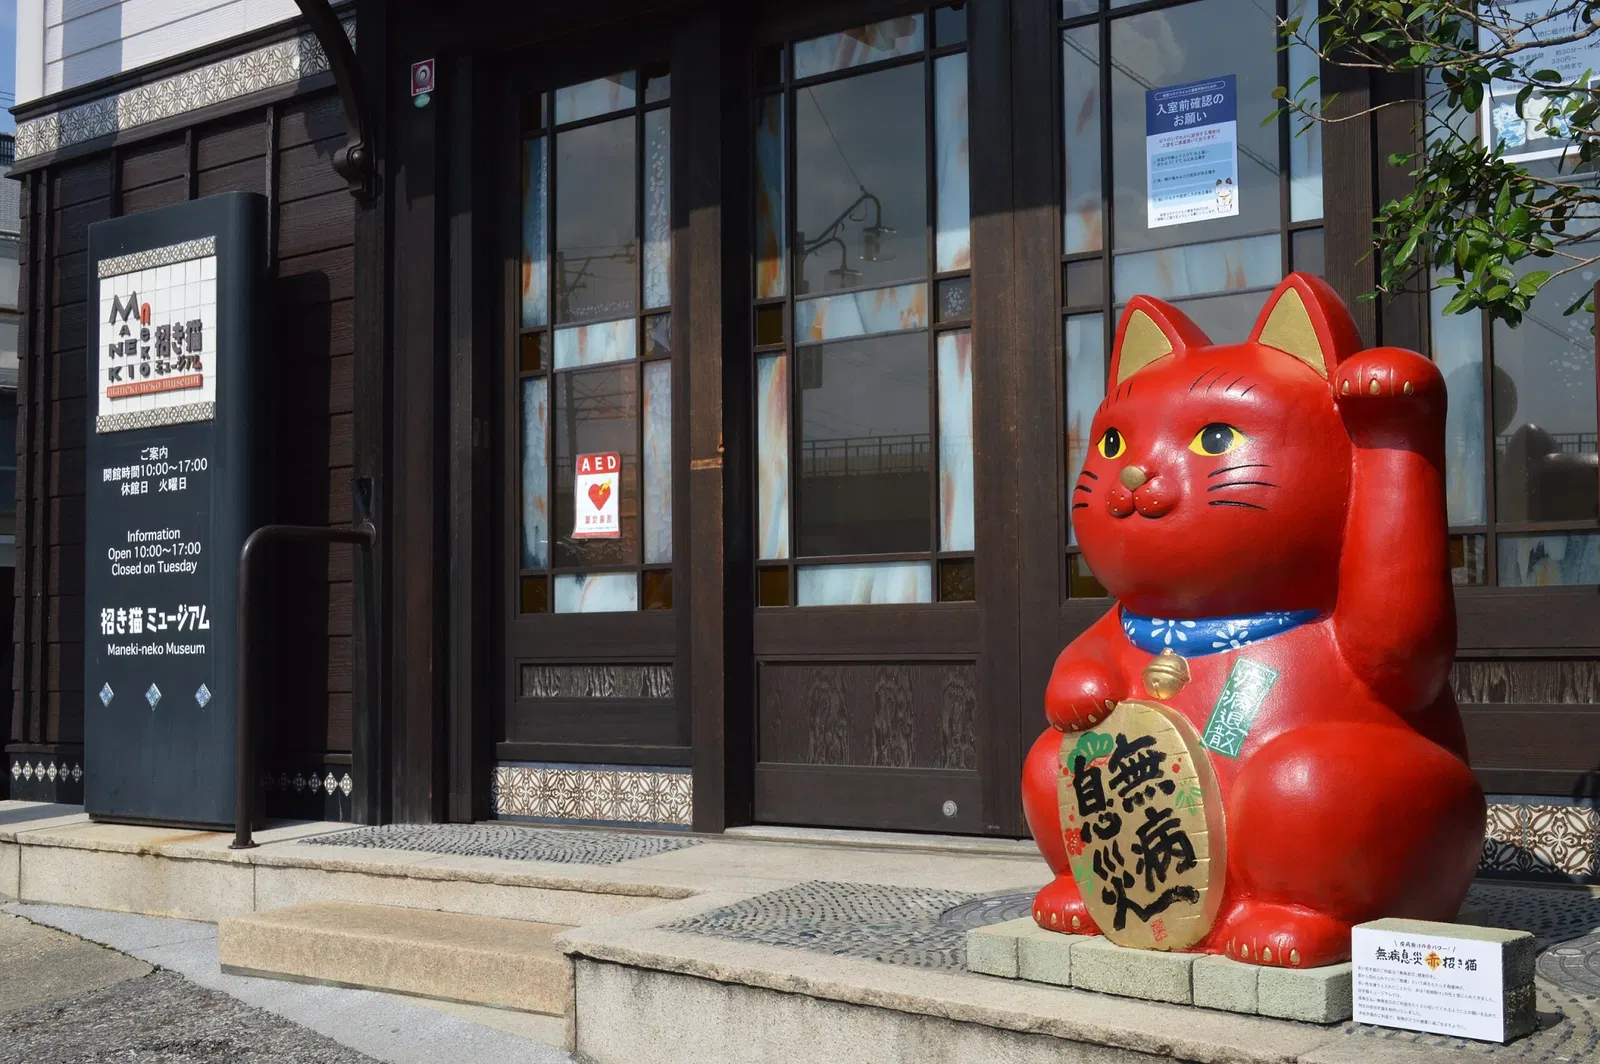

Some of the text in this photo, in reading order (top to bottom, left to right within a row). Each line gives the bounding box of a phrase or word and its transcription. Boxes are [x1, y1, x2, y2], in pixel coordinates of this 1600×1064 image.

[1156, 93, 1224, 116] 入室前確認の
[1173, 111, 1207, 127] お願い
[154, 319, 203, 358] 招き猫
[154, 354, 203, 376] ミュージアム
[140, 446, 168, 461] ご案内
[582, 455, 616, 472] AED
[121, 477, 187, 496] 休館日 火曜日
[127, 527, 181, 543] Information
[108, 547, 132, 562] Open
[111, 559, 198, 576] Closed on Tuesday
[107, 642, 205, 656] Maneki-neko Museum
[1107, 732, 1198, 892] 無病
